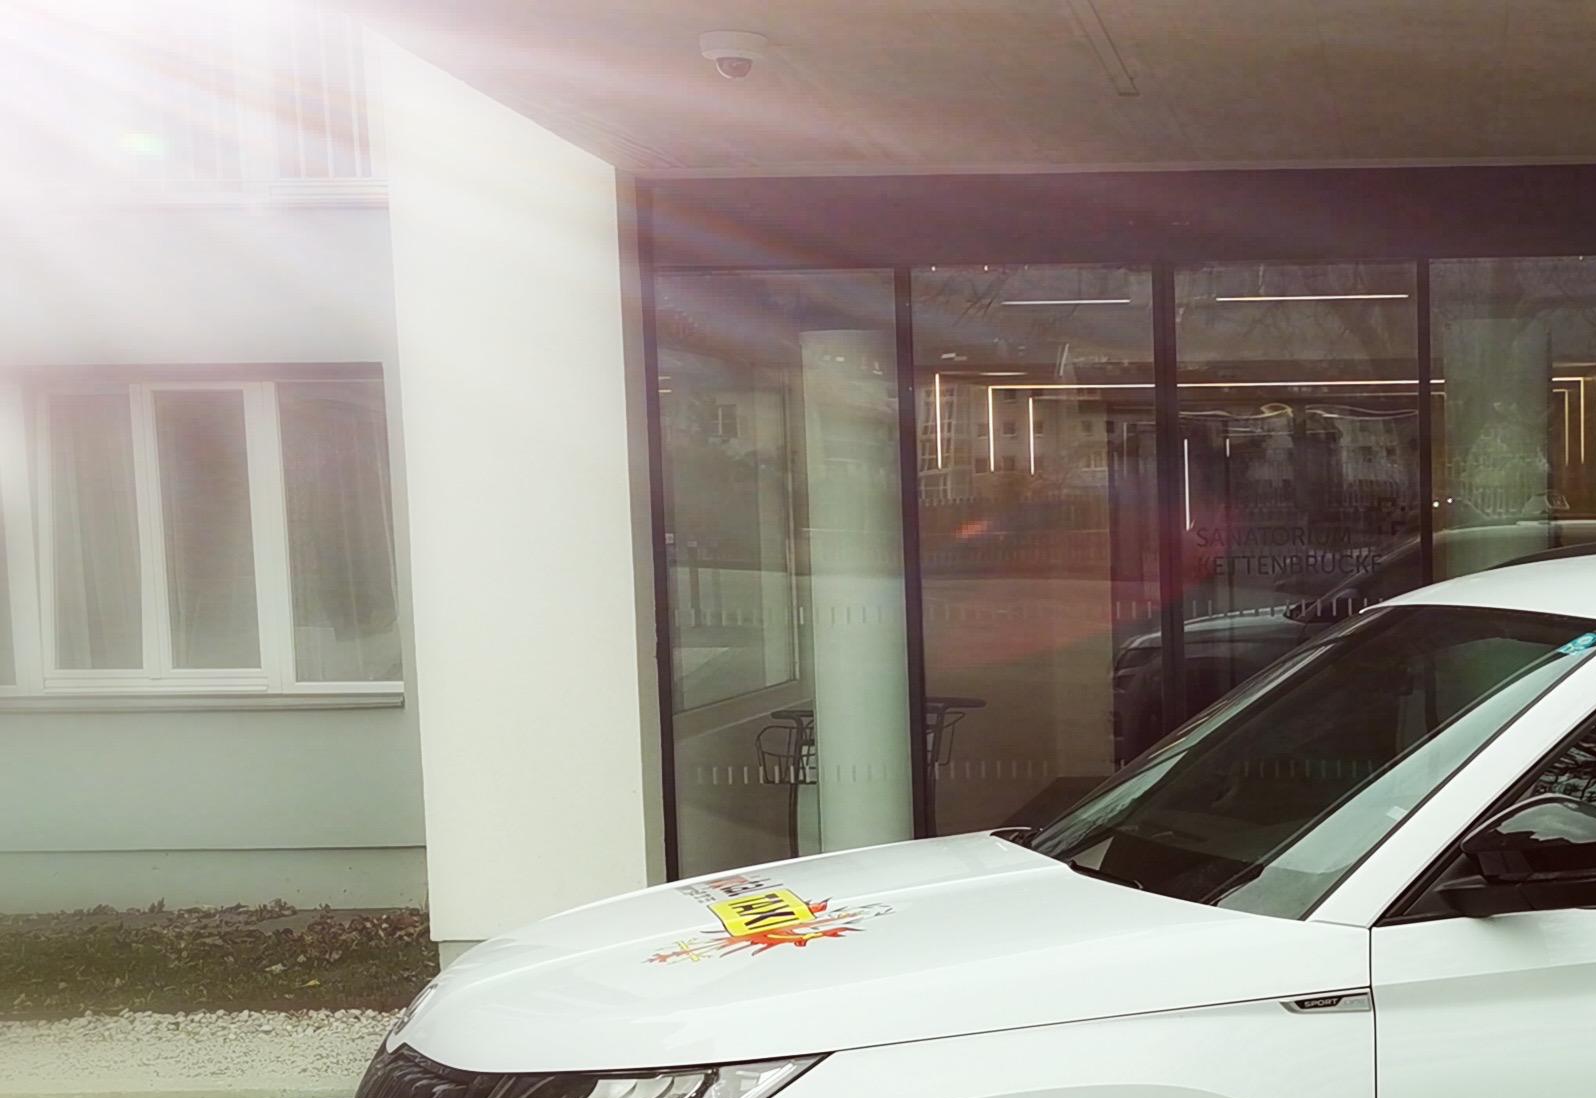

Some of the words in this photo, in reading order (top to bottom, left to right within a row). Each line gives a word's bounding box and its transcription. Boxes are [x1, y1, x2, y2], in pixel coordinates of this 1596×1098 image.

[1196, 526, 1352, 548] SANATORIUM
[729, 893, 799, 930] TAXI
[1305, 998, 1337, 1008] SPORT
